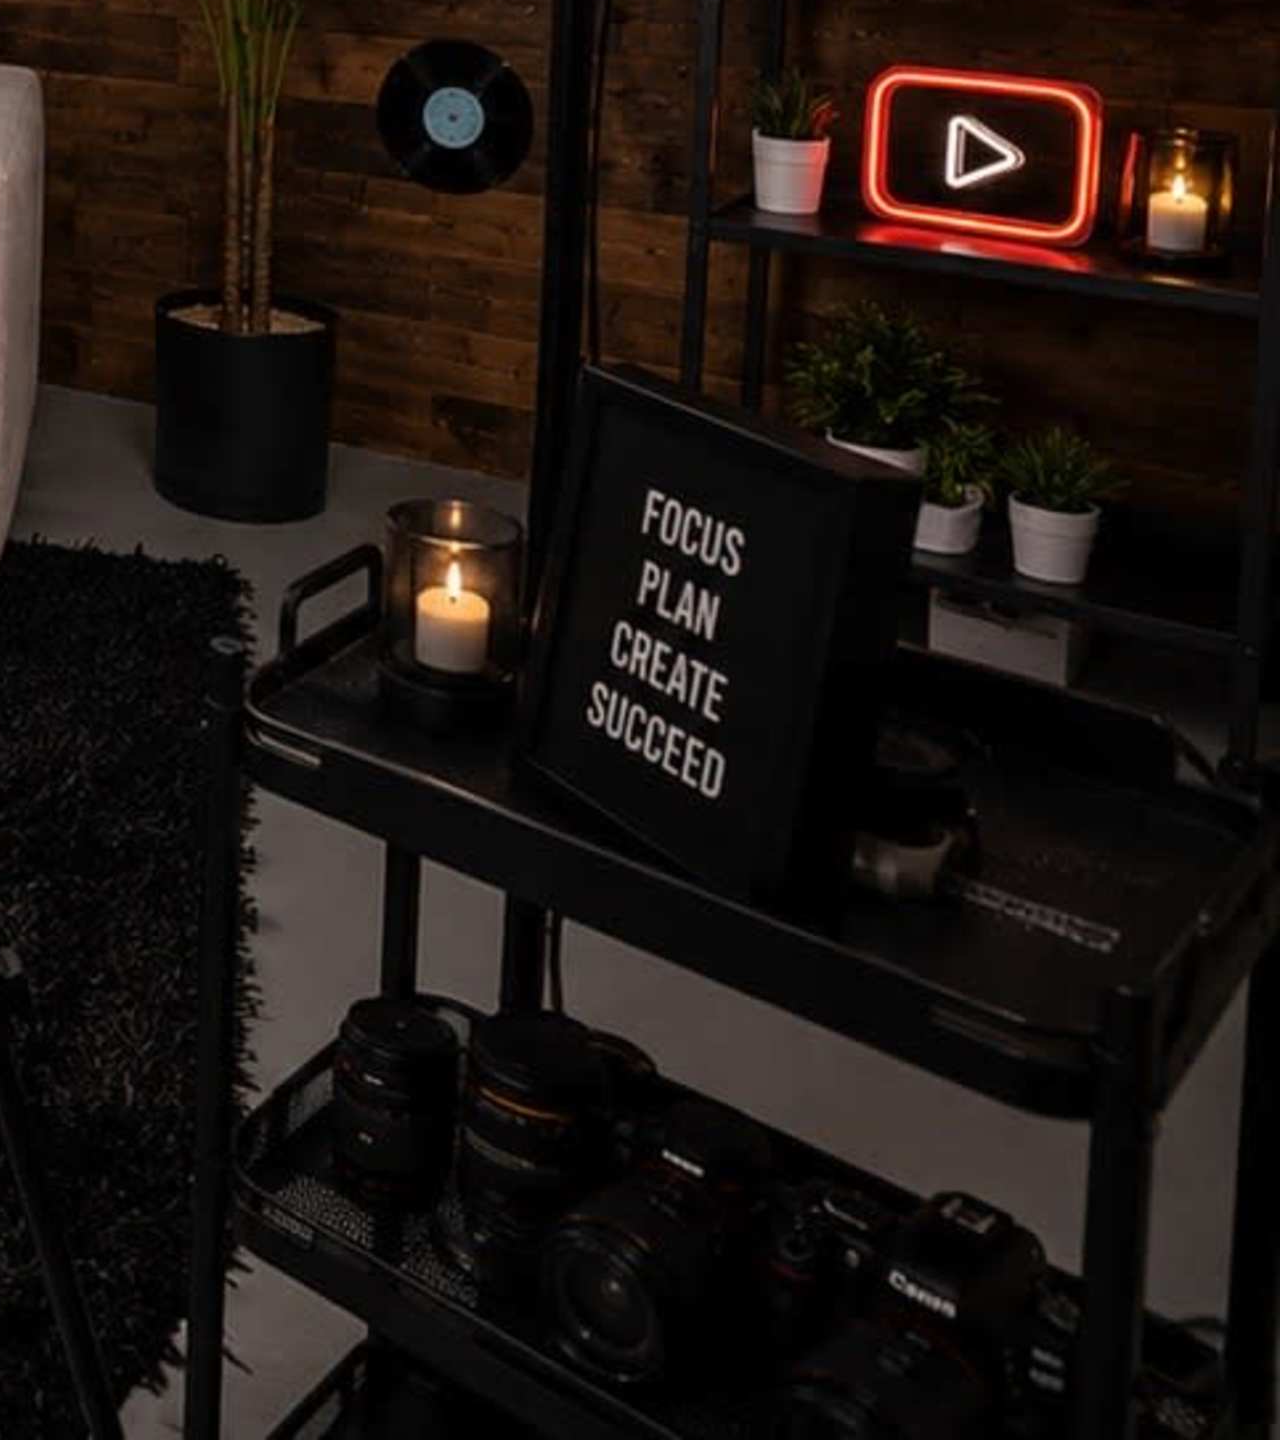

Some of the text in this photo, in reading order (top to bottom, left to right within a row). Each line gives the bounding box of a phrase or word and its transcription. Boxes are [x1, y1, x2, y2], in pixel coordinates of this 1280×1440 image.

[640, 488, 746, 577] FOCUS
[637, 560, 721, 642] PLAN
[609, 620, 730, 723] CREATE
[585, 680, 726, 800] SUCCEED
